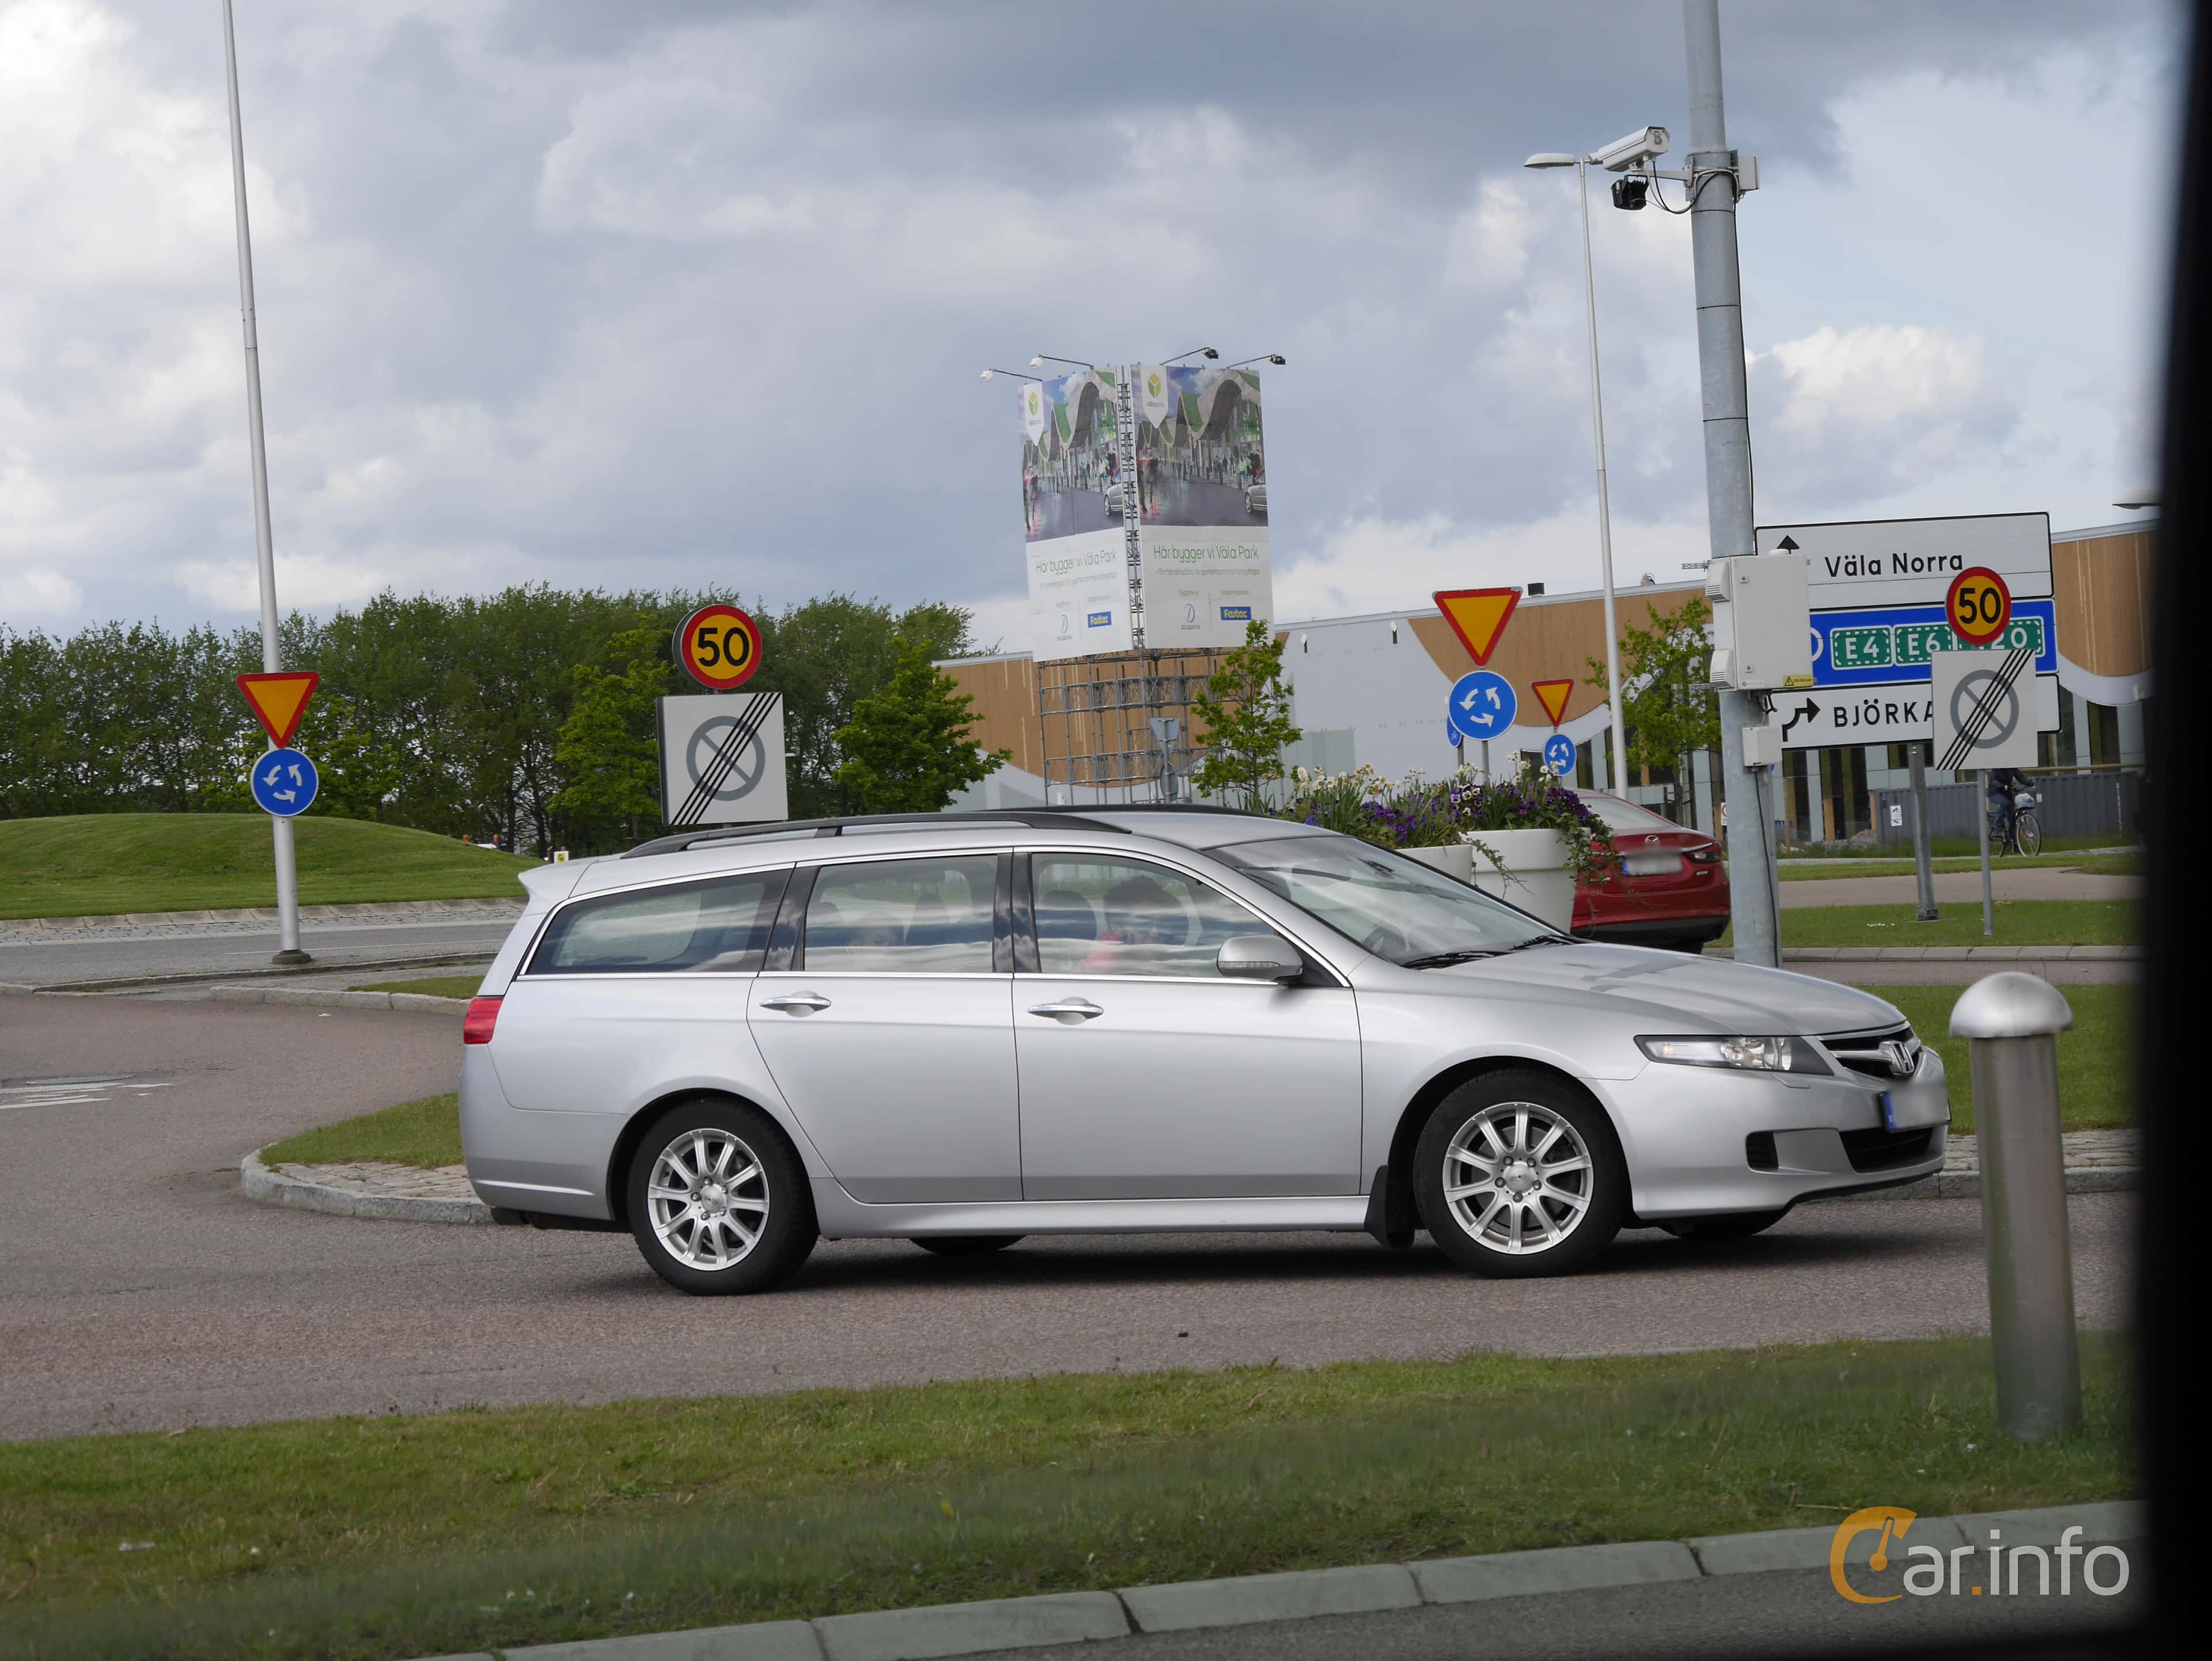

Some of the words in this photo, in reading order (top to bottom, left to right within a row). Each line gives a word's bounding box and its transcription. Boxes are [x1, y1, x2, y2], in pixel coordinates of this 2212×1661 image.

[1050, 557, 1075, 576] bygger
[1076, 554, 1082, 567] vi
[1101, 548, 1116, 563] Park
[1154, 545, 1170, 559] Här
[1172, 545, 1206, 563] bygger
[1207, 547, 1215, 559] vi
[1216, 545, 1236, 559] Väla
[1238, 544, 1259, 559] Park
[1824, 555, 1881, 577] Väla
[1892, 553, 1963, 574] Norra
[1959, 588, 2002, 625] 50
[697, 627, 750, 667] 50
